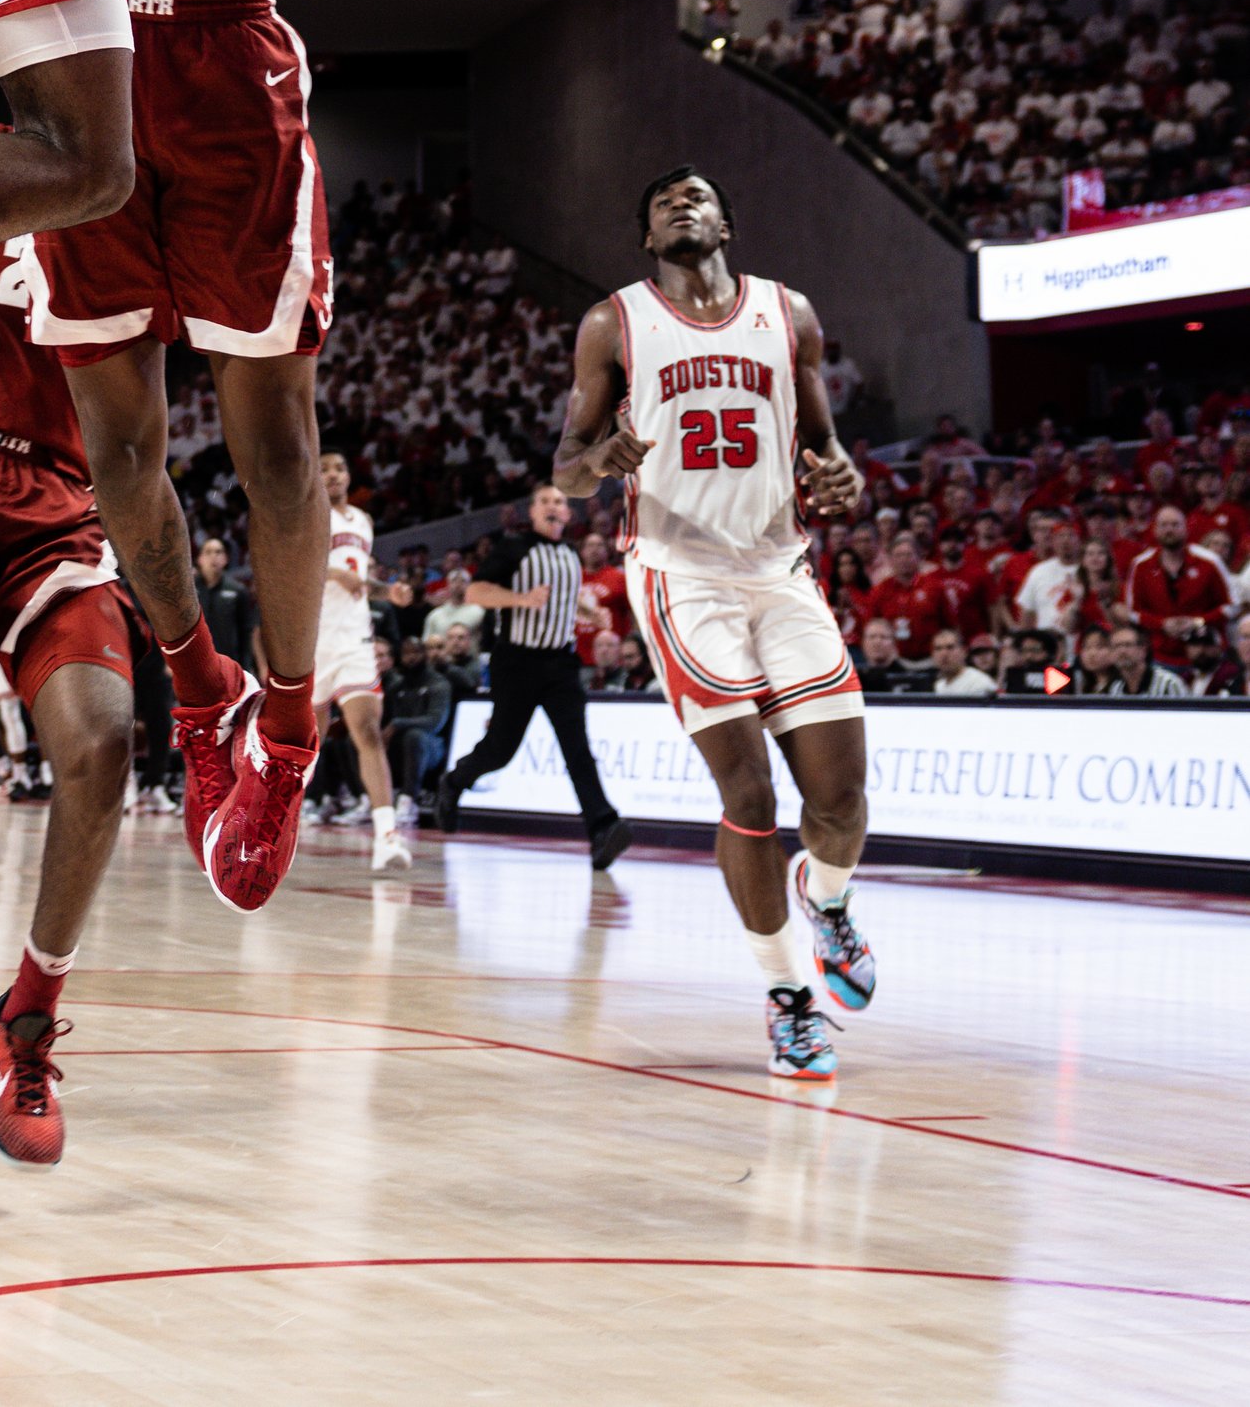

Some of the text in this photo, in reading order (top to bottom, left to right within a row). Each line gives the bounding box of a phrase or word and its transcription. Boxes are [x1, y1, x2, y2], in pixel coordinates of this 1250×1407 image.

[1042, 254, 1171, 291] Higginbotham
[658, 354, 774, 405] HOUSTON
[680, 408, 759, 471] 25
[520, 737, 641, 780] NARAL
[869, 746, 1070, 802] STERFULLY
